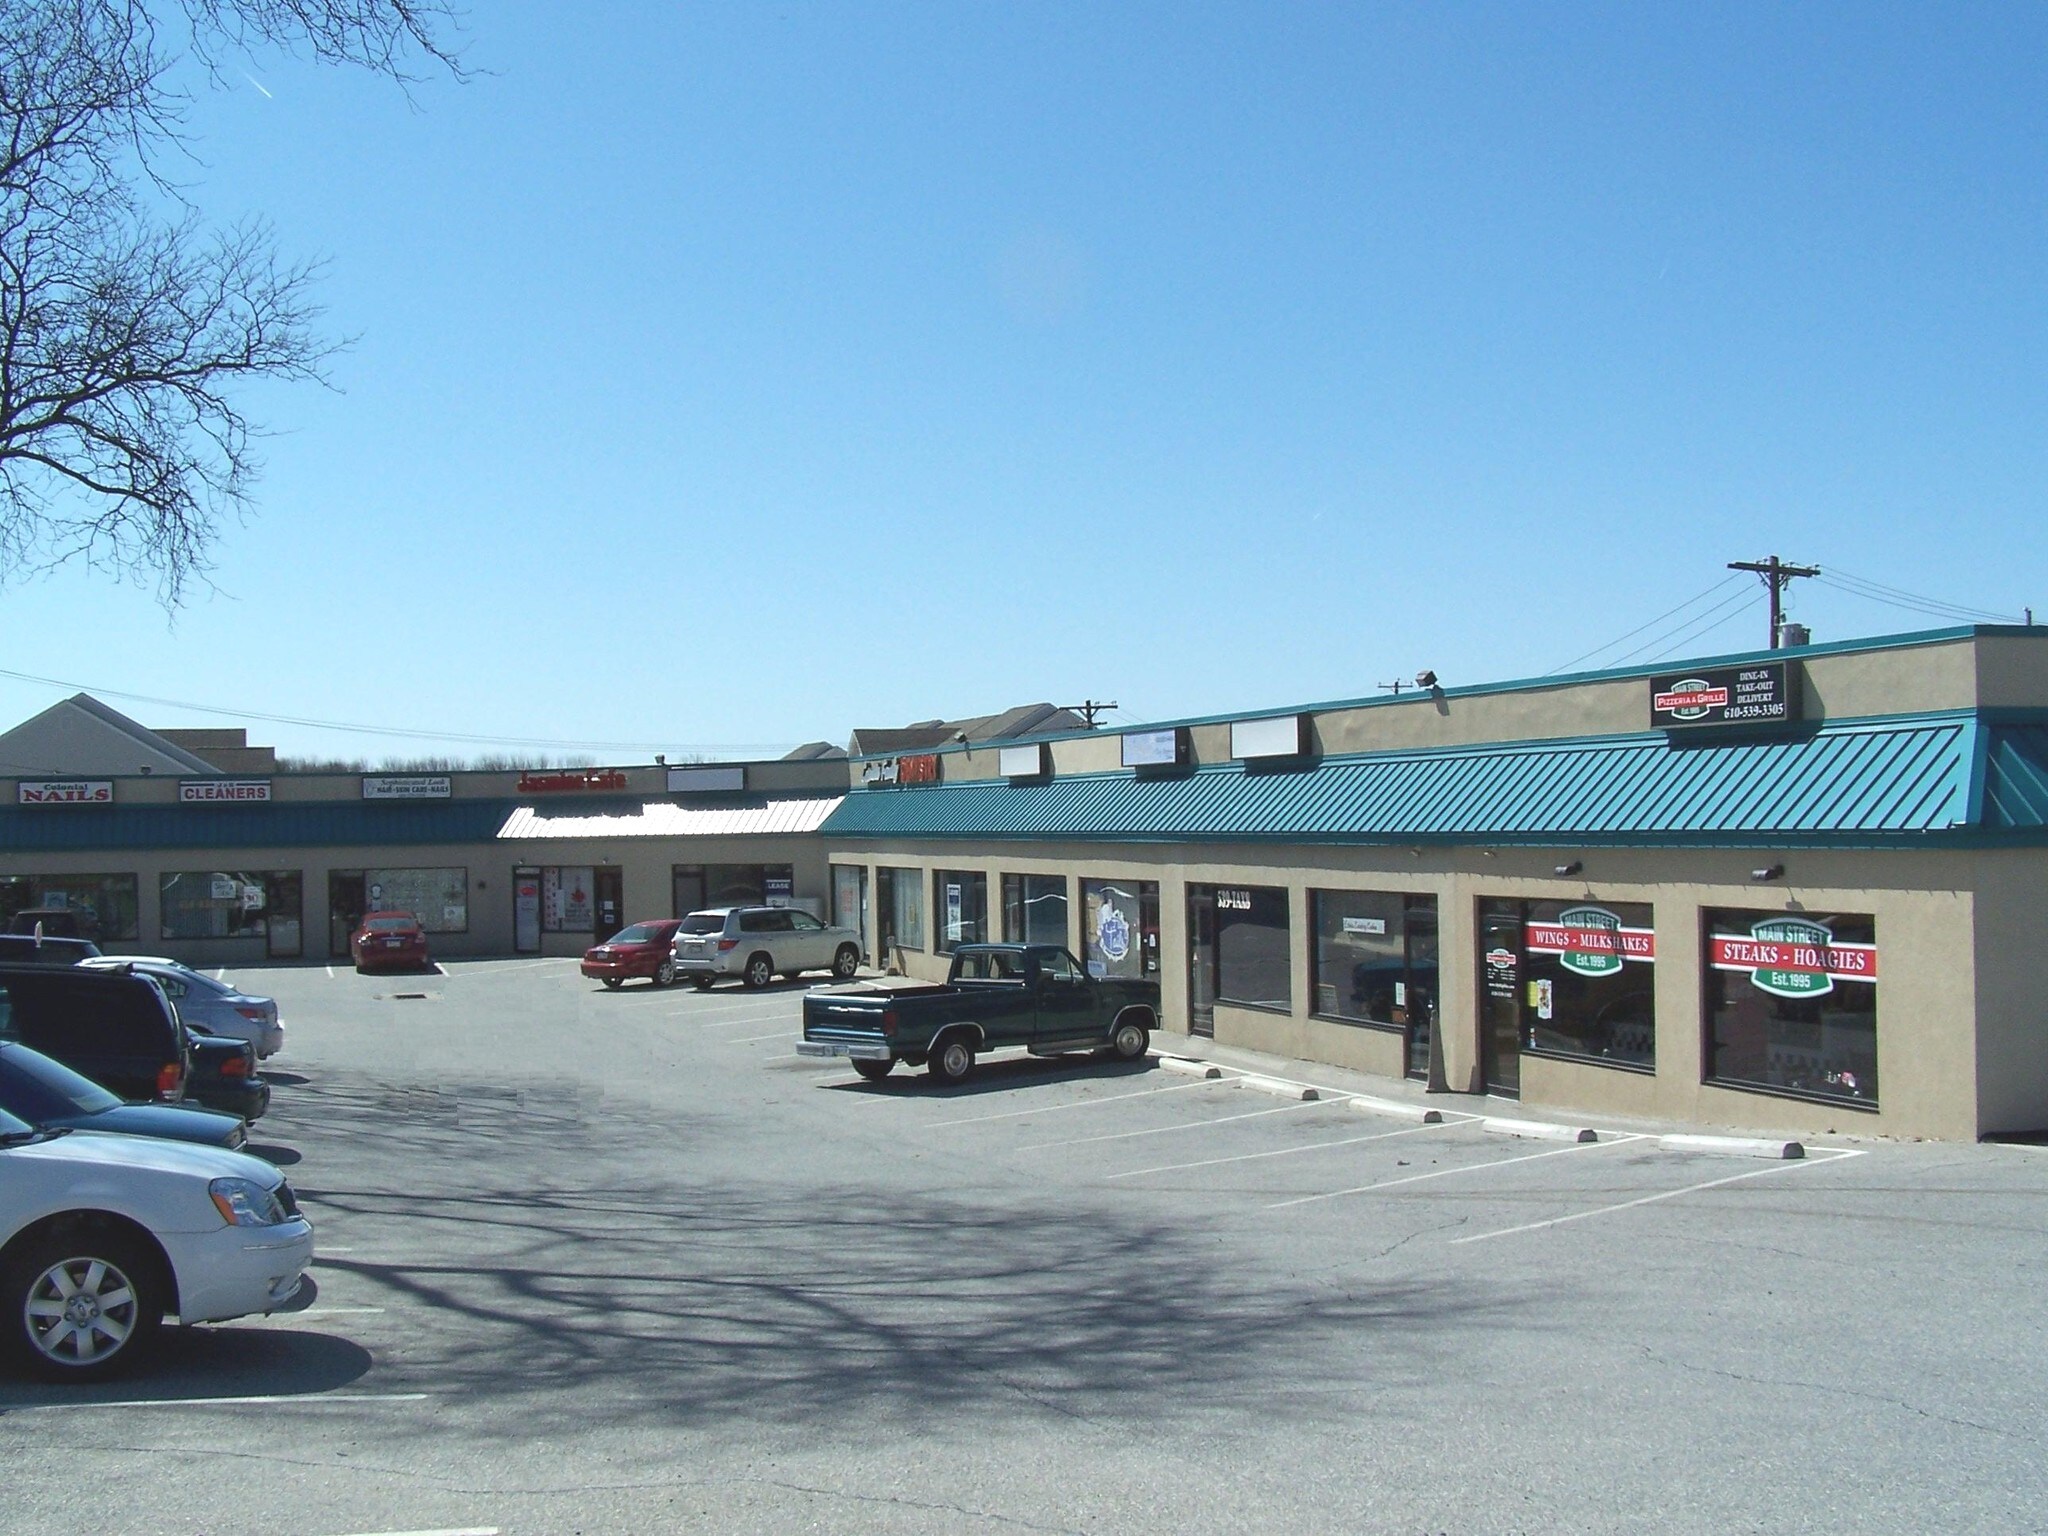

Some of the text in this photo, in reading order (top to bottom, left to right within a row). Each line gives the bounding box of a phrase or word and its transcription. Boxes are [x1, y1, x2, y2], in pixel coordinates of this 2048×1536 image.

[1739, 670, 1769, 681] DINE-IN
[1736, 681, 1774, 693] TAKE-OUT
[1737, 692, 1774, 704] DELIVERY
[1723, 703, 1784, 719] 610-539-3305
[23, 789, 109, 801] NAILS
[184, 787, 266, 799] CLEANERS
[1565, 913, 1615, 930] MAIN STREET
[1535, 931, 1570, 945] WINGS
[1580, 934, 1649, 952] MILKSHAKES
[1758, 925, 1824, 945] MAIN STREET
[1576, 954, 1589, 966] Est.
[1723, 943, 1778, 963] STEAKS
[1793, 948, 1865, 971] HOAGIES
[1771, 972, 1811, 988] Est. 1995
